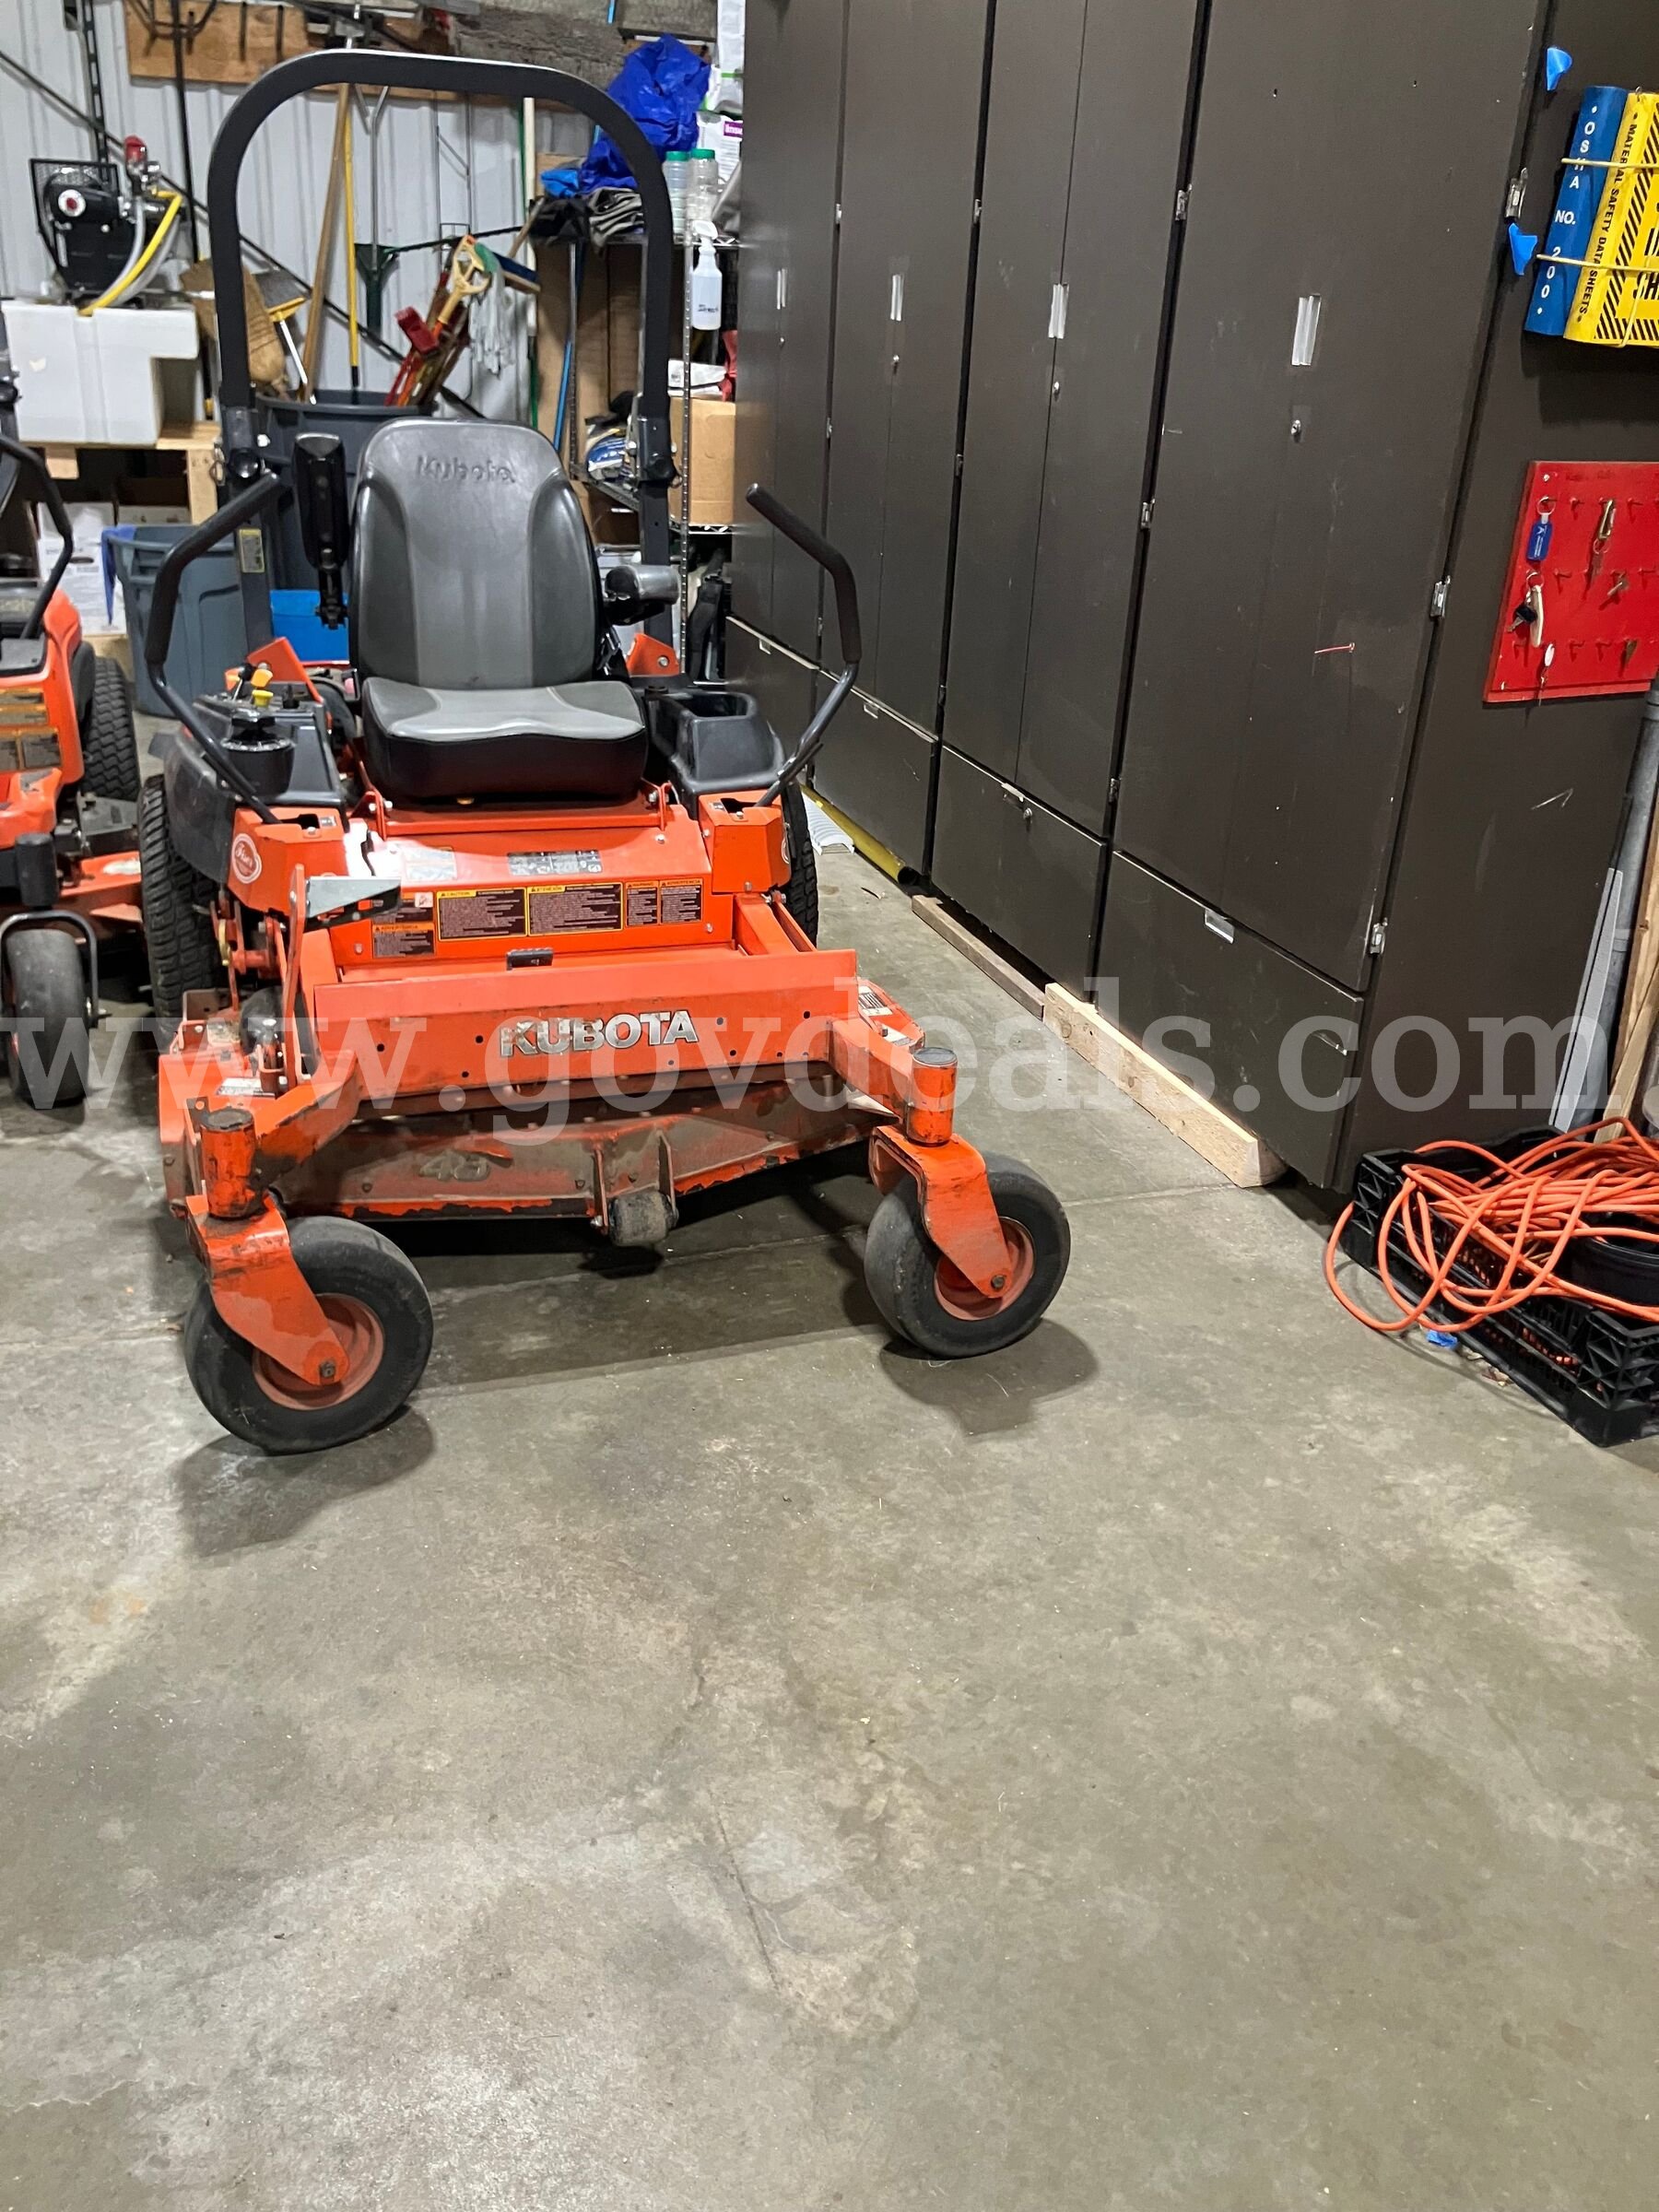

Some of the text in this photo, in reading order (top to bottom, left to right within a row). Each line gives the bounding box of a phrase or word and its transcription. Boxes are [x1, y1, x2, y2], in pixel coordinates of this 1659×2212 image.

[1555, 209, 1576, 225] NO.
[1579, 124, 1638, 314] MATERAL SAFETY DATA SHEETS
[1541, 246, 1561, 299] 200
[499, 1009, 699, 1058] KUBOTA
